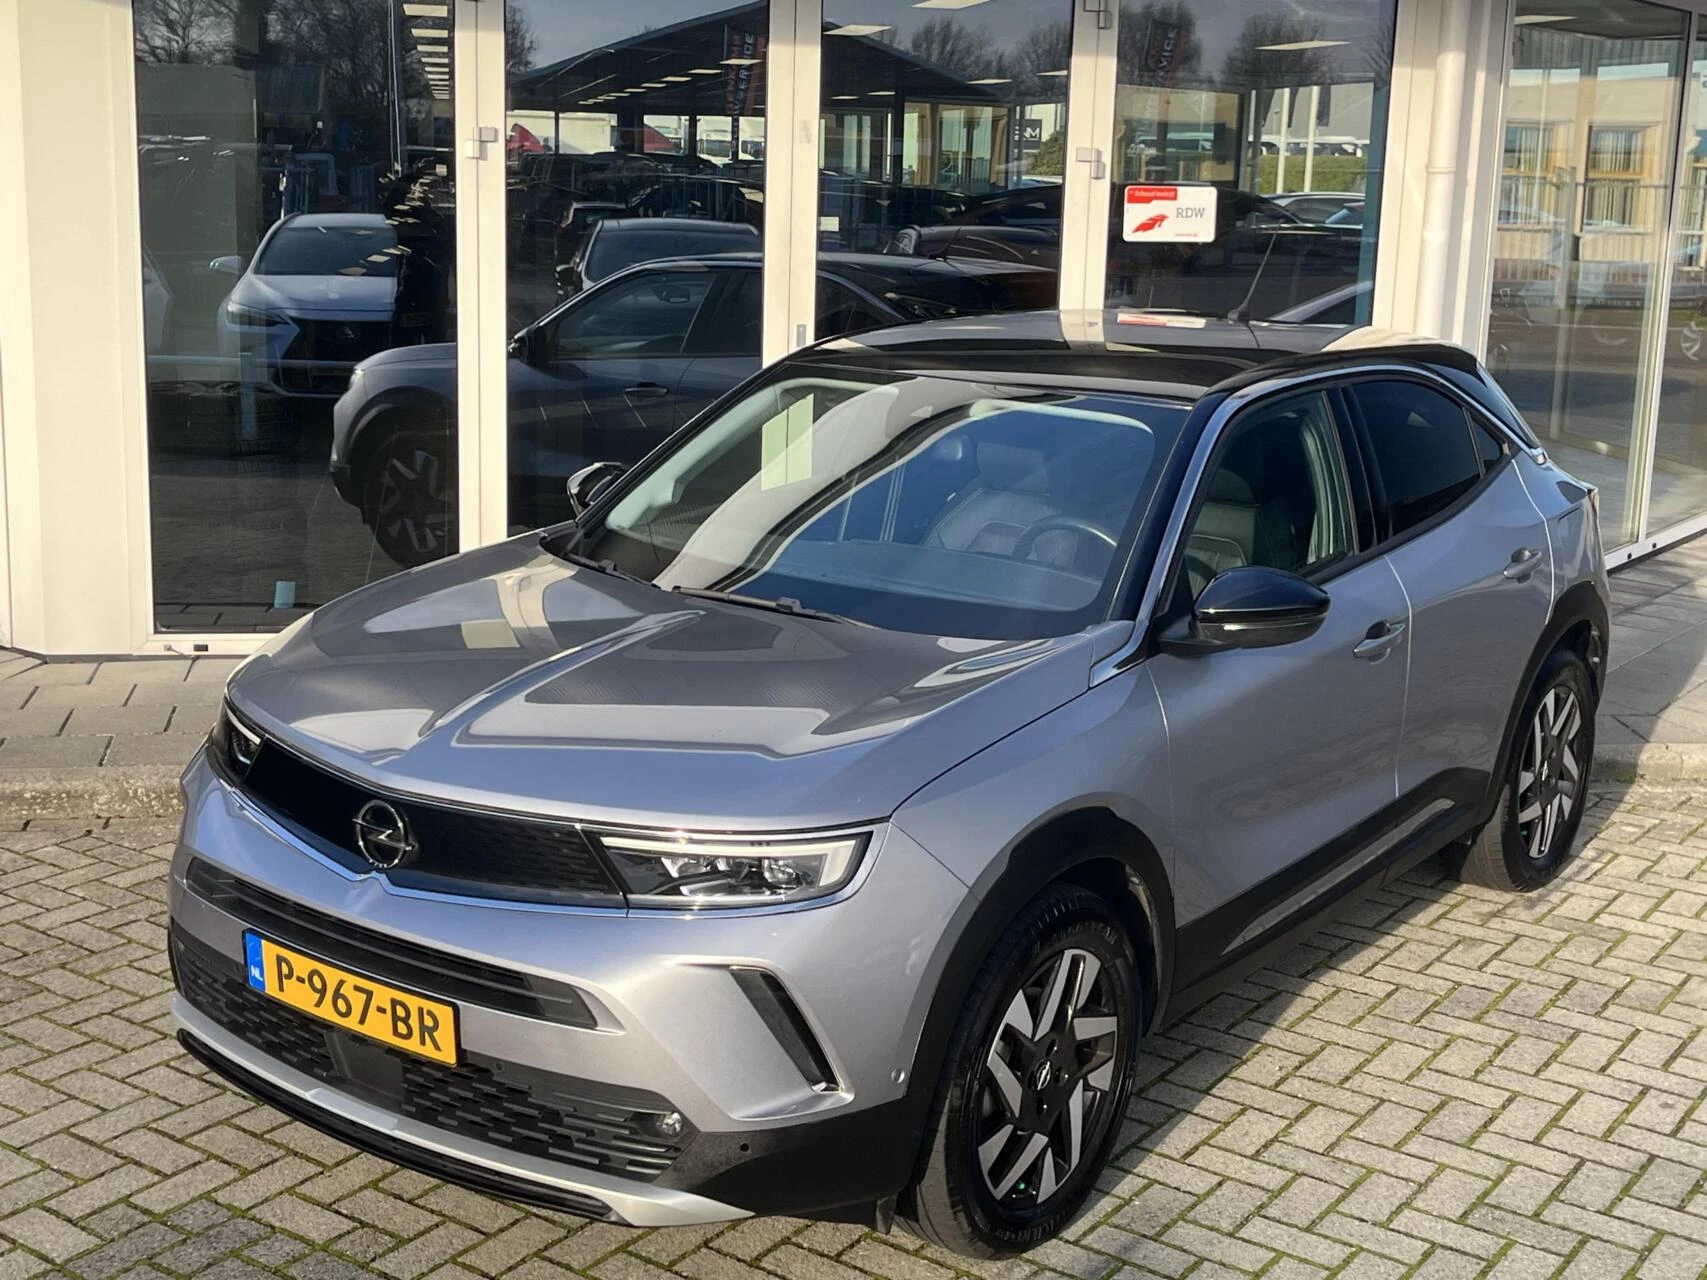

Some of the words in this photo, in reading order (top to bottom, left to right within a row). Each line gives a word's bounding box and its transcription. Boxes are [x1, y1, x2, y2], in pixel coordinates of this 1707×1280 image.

[1175, 207, 1206, 219] RDW
[250, 965, 264, 981] NL
[275, 953, 443, 1052] P-967-BR
